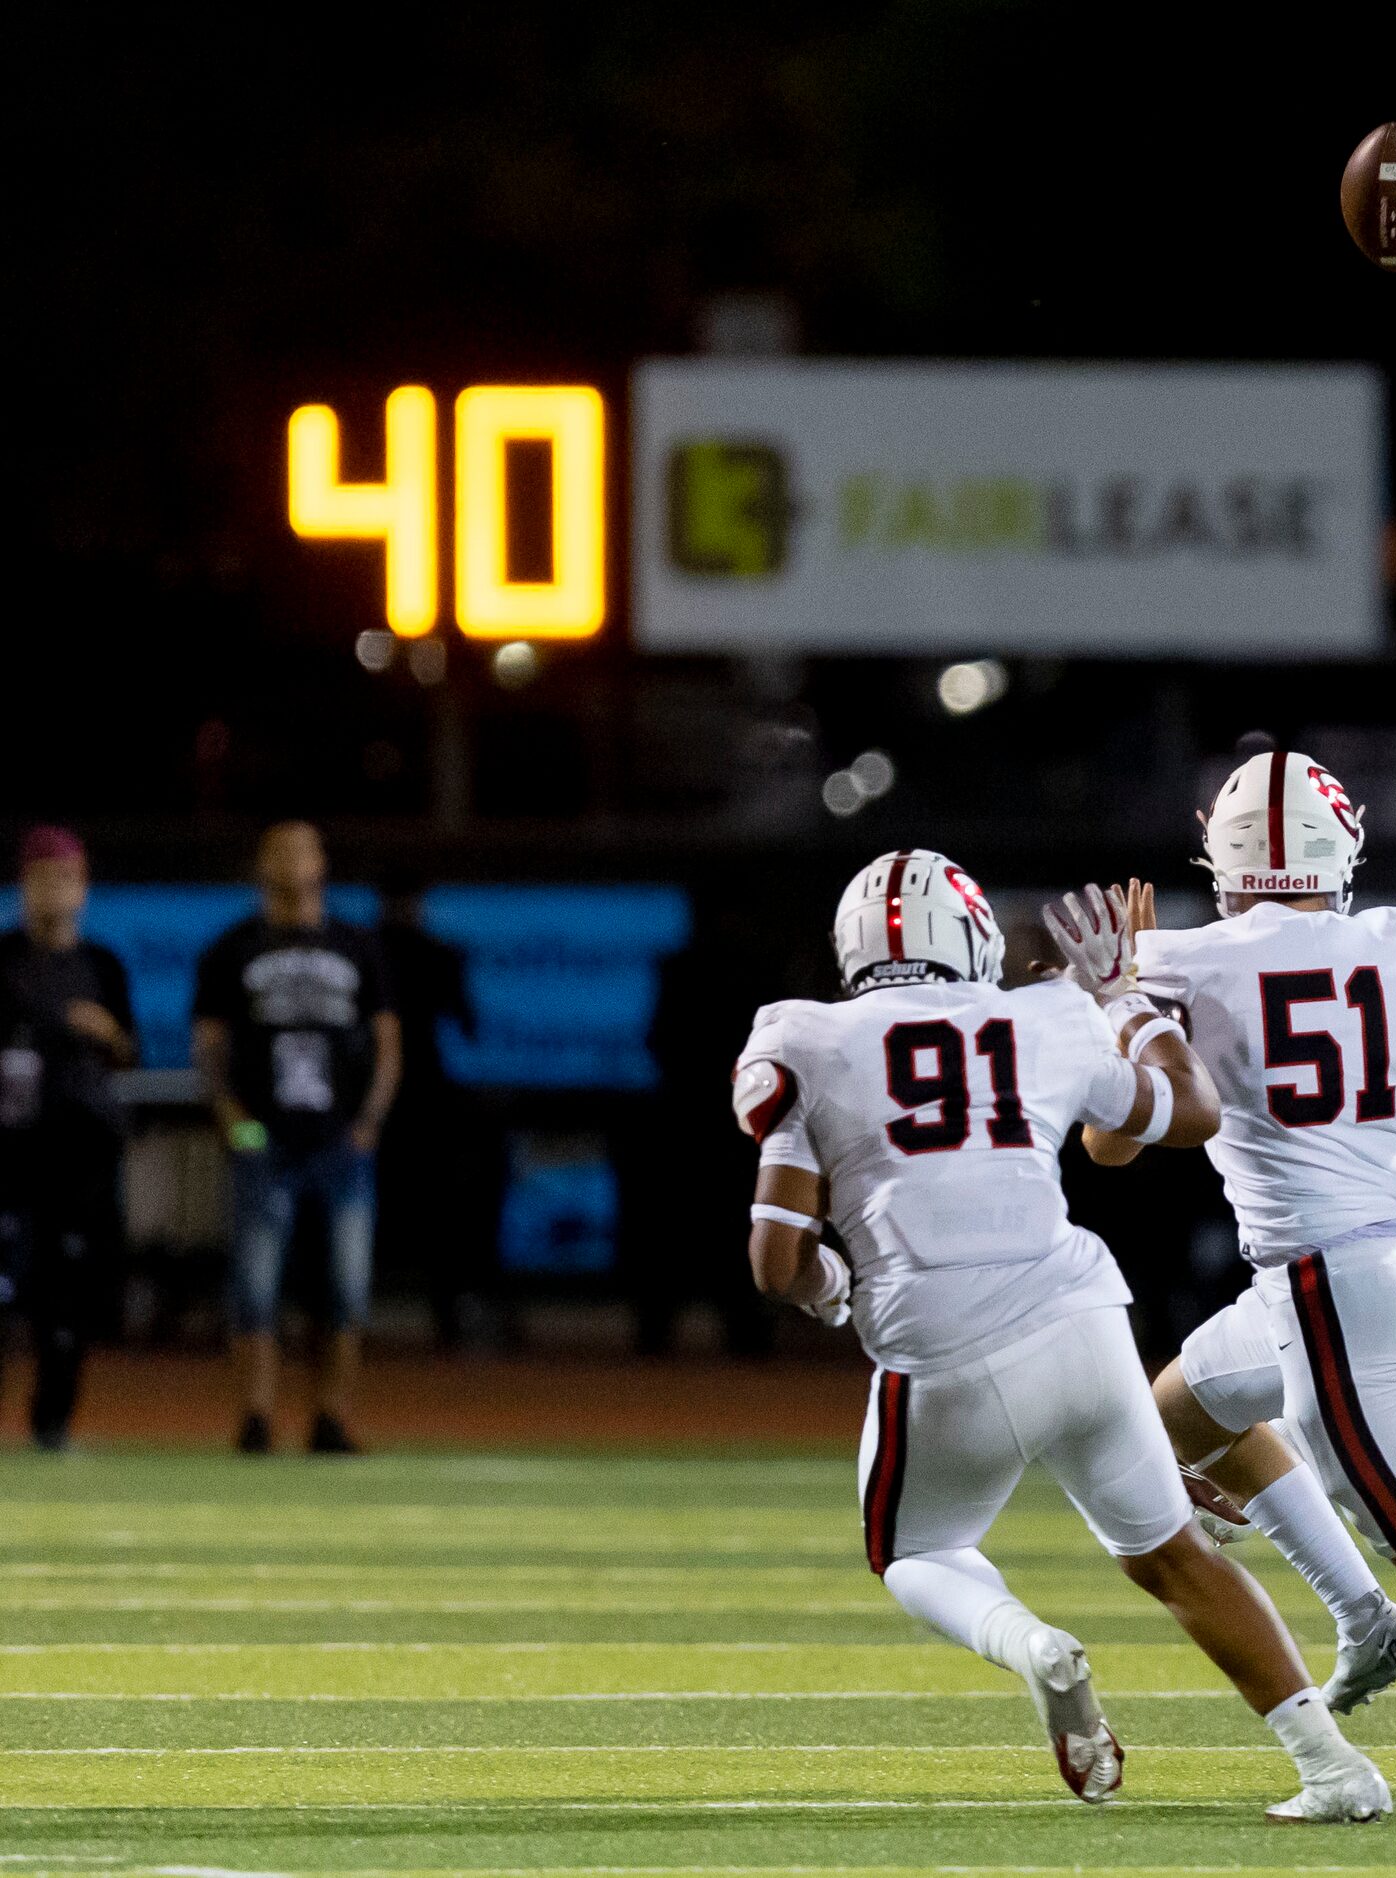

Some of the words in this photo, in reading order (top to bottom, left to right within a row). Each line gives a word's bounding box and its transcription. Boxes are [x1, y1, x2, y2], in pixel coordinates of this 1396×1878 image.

[287, 384, 606, 640] 40
[838, 472, 1320, 556] FAIRLEASE
[1242, 874, 1319, 890] Riddell
[883, 1017, 1034, 1156] 91
[1258, 964, 1396, 1129] 51
